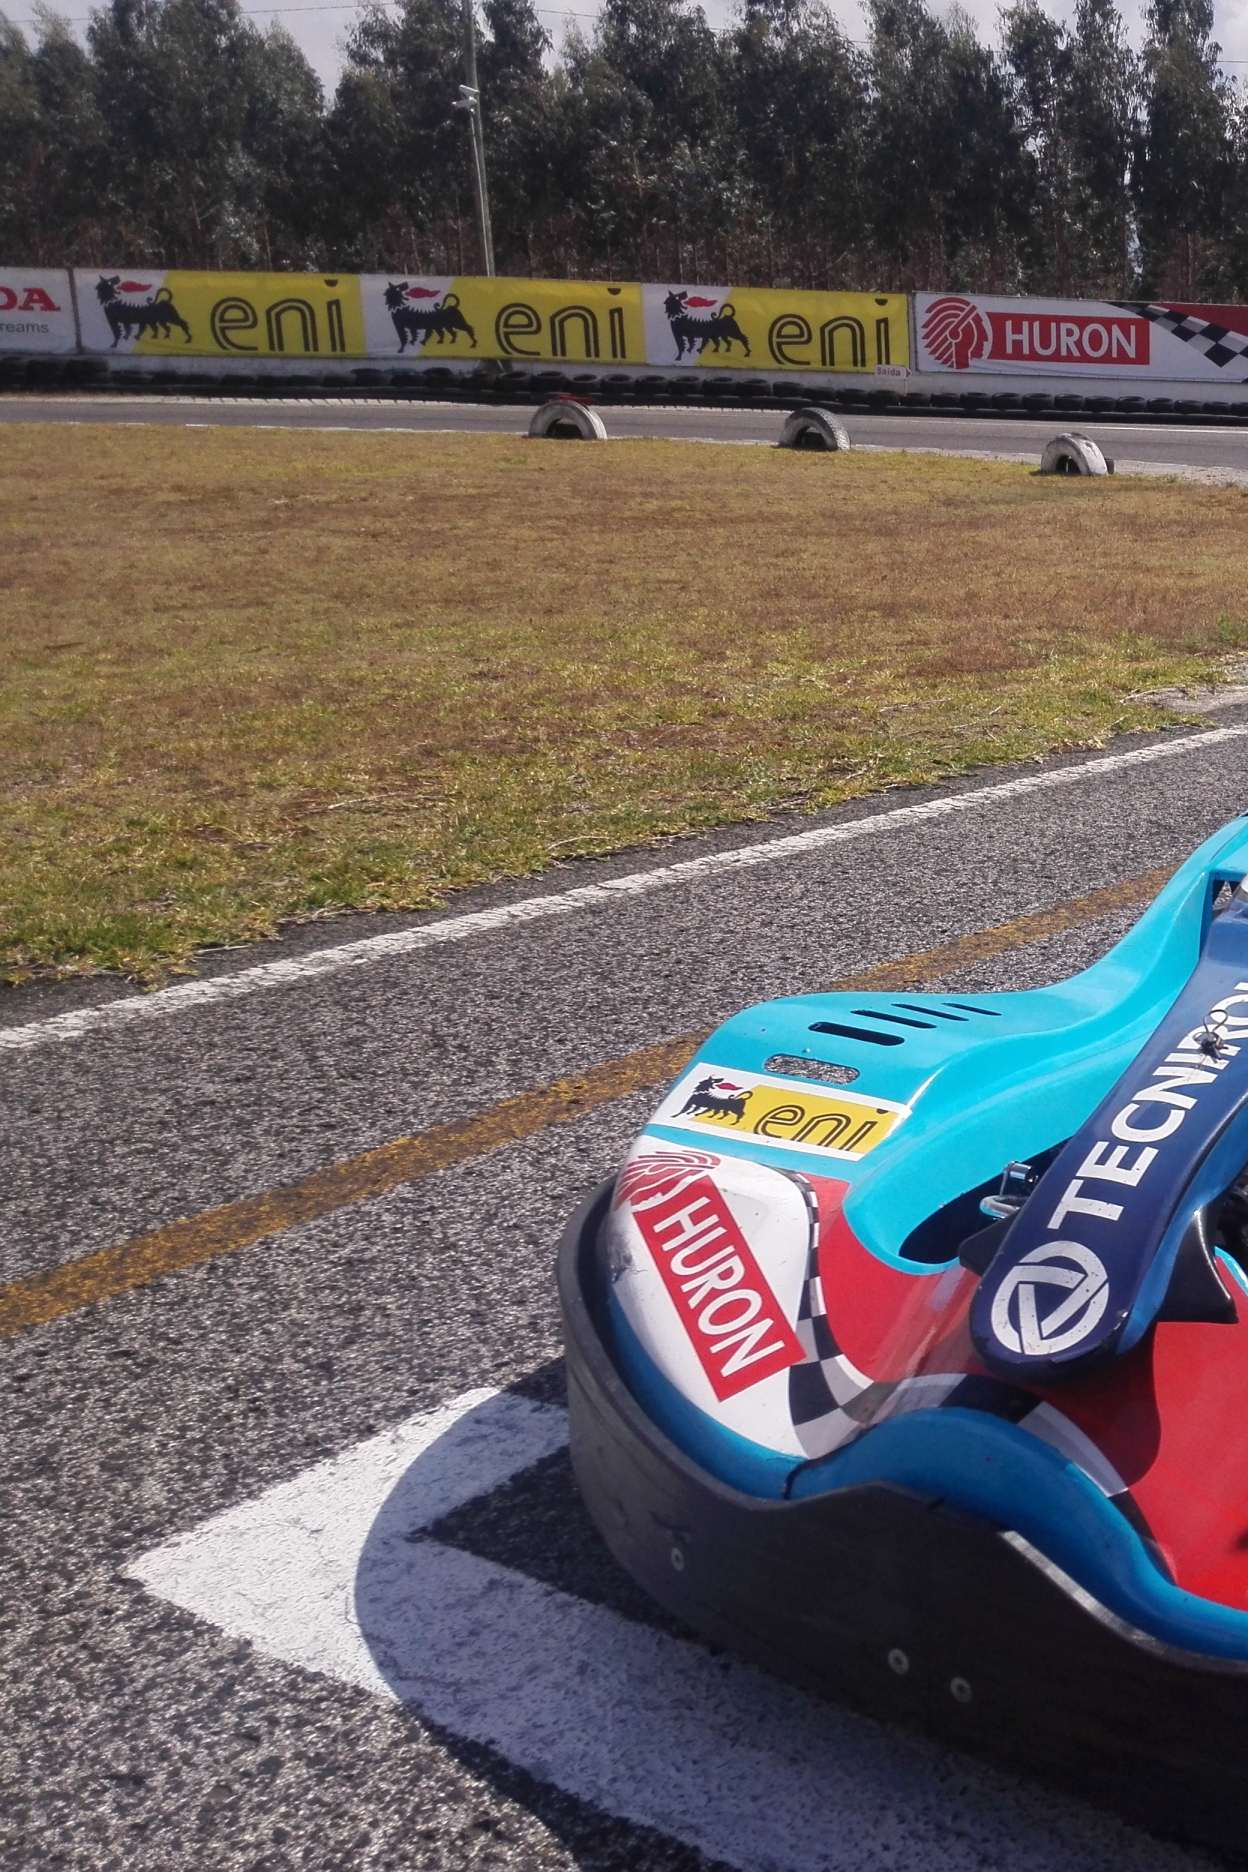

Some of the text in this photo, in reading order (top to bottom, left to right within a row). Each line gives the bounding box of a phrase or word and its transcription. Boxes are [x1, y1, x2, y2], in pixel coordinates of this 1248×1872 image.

[210, 279, 346, 353] eni
[495, 288, 627, 359] eni
[768, 298, 890, 368] eni
[1005, 320, 1137, 359] HURON
[753, 1107, 889, 1152] eni
[653, 1195, 785, 1378] HURON
